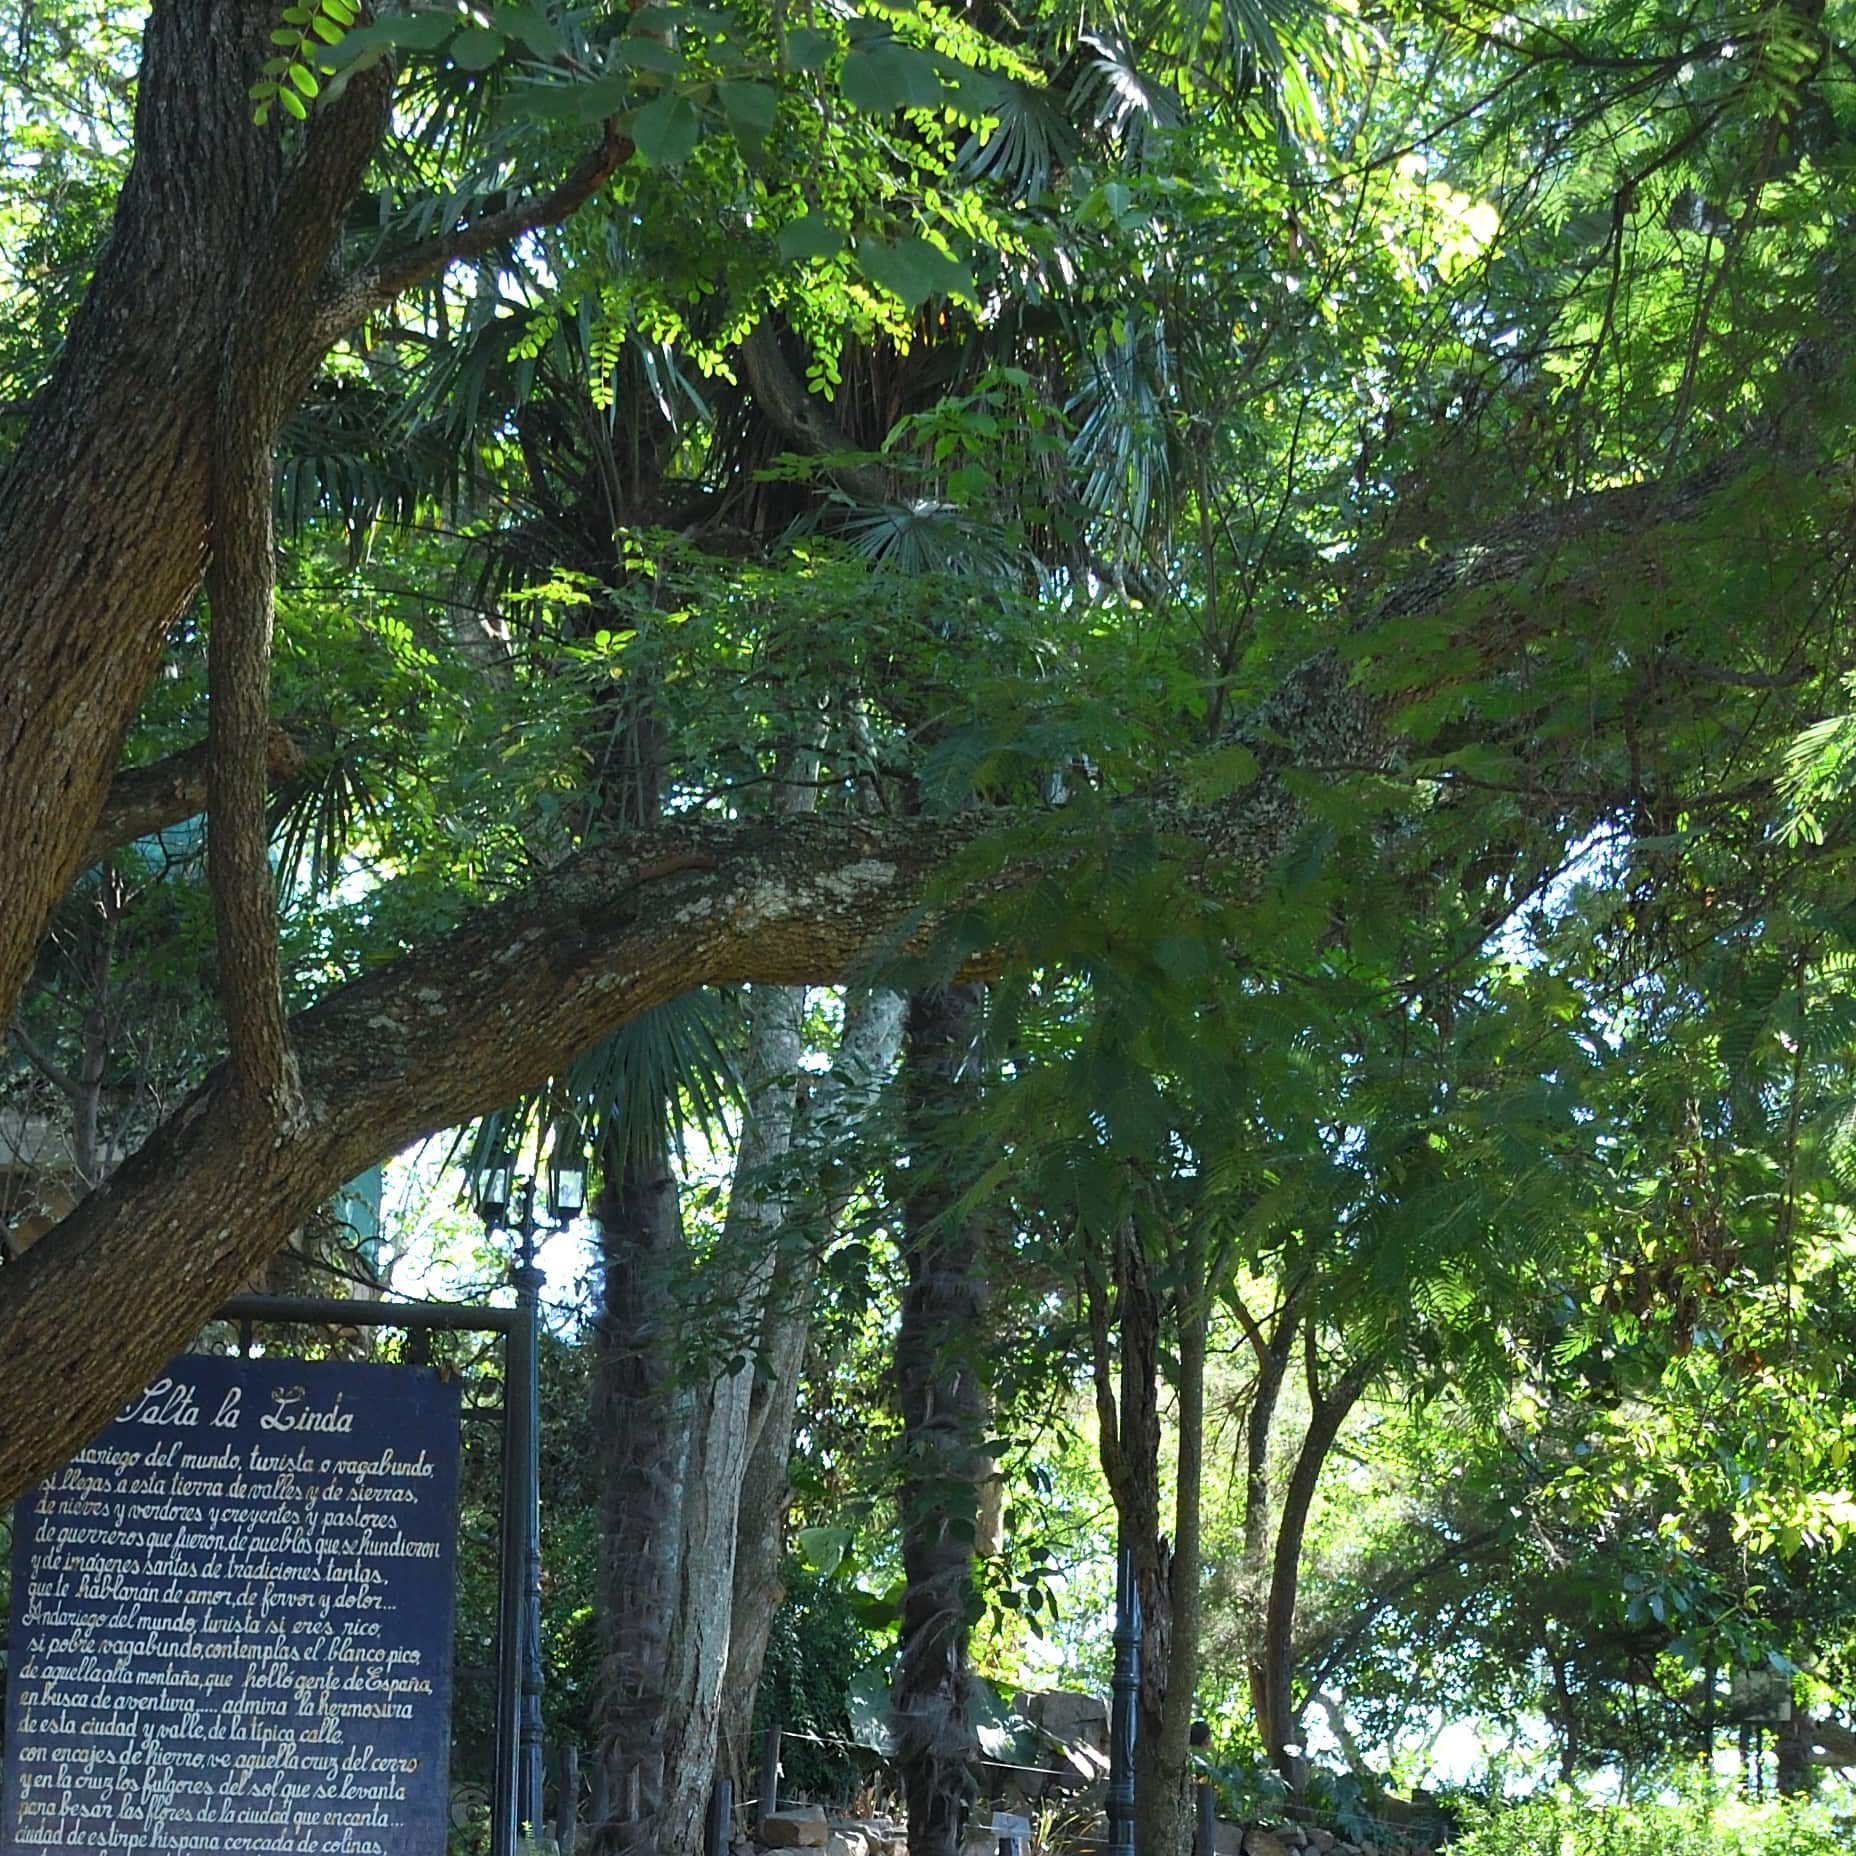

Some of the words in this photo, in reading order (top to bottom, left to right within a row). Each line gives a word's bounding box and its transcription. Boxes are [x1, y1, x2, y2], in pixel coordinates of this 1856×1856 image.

[116, 1378, 200, 1426] Salta
[211, 1387, 241, 1429] la
[261, 1386, 354, 1433] Linda
[145, 1441, 183, 1468] del
[250, 1444, 314, 1473] turista
[39, 1472, 57, 1492] si
[58, 1468, 112, 1500] llegas
[129, 1471, 165, 1494] esta
[172, 1472, 223, 1498] tierra
[226, 1473, 245, 1500] de
[248, 1473, 303, 1501] valles
[322, 1477, 344, 1501] de
[34, 1490, 54, 1515] de
[59, 1500, 110, 1518] nieves
[223, 1501, 300, 1533] creyentes
[321, 1503, 398, 1535] pastores
[35, 1518, 54, 1544] de
[57, 1525, 144, 1553] guerreros
[147, 1531, 173, 1559] que
[230, 1526, 248, 1552] de
[248, 1526, 313, 1564] pueblos
[343, 1539, 359, 1556] se
[359, 1528, 441, 1559] hundieron
[44, 1546, 62, 1571] de
[64, 1552, 141, 1583] imágenes
[144, 1551, 199, 1578] santas
[202, 1553, 222, 1578] de
[225, 1554, 321, 1581] tradiciones
[29, 1581, 54, 1602] que
[76, 1574, 159, 1603] hablarán
[163, 1578, 183, 1604] de
[237, 1582, 258, 1607] de
[261, 1581, 317, 1618] fervor
[23, 1600, 111, 1637] Andariego
[109, 1603, 141, 1630] del
[202, 1607, 260, 1635] turista
[266, 1616, 286, 1635] si
[292, 1618, 334, 1636] eres
[28, 1633, 45, 1653] si
[47, 1628, 96, 1660] pobre
[205, 1635, 301, 1670] contemplas
[305, 1636, 325, 1661] el
[326, 1637, 386, 1662] blanco
[20, 1655, 37, 1679] de
[41, 1656, 101, 1684] aquella
[103, 1657, 134, 1684] alta
[204, 1674, 234, 1697] que
[242, 1662, 296, 1689] holló
[294, 1665, 342, 1700] gente
[344, 1665, 364, 1691] de
[20, 1690, 39, 1706] en
[41, 1682, 88, 1708] busca
[91, 1684, 112, 1710] de
[222, 1689, 289, 1716] admira
[296, 1690, 314, 1717] la
[318, 1692, 414, 1720] hermosura
[18, 1707, 38, 1734] de
[41, 1708, 76, 1734] esta
[80, 1711, 140, 1738] ciudad
[250, 1716, 295, 1752] típica
[20, 1745, 48, 1763] con
[52, 1745, 116, 1775] encajes
[119, 1738, 143, 1766] de
[207, 1754, 232, 1769] ve
[234, 1743, 299, 1776] aquella
[303, 1755, 339, 1781] cruz
[342, 1744, 374, 1773] del
[371, 1756, 420, 1774] cerro
[76, 1774, 114, 1801] cruz
[116, 1766, 140, 1793] los
[141, 1766, 216, 1805] fulgores
[220, 1770, 250, 1797] del
[248, 1771, 284, 1798] sol
[282, 1783, 311, 1808] que
[311, 1784, 338, 1800] se
[337, 1773, 407, 1801] levanta
[19, 1800, 56, 1825] para
[59, 1790, 113, 1819] besar
[119, 1792, 144, 1820] las
[146, 1795, 194, 1832] flores
[238, 1798, 290, 1825] ciudad
[294, 1812, 321, 1836] que
[15, 1817, 64, 1845] ciudad
[225, 1828, 293, 1853] cercada
